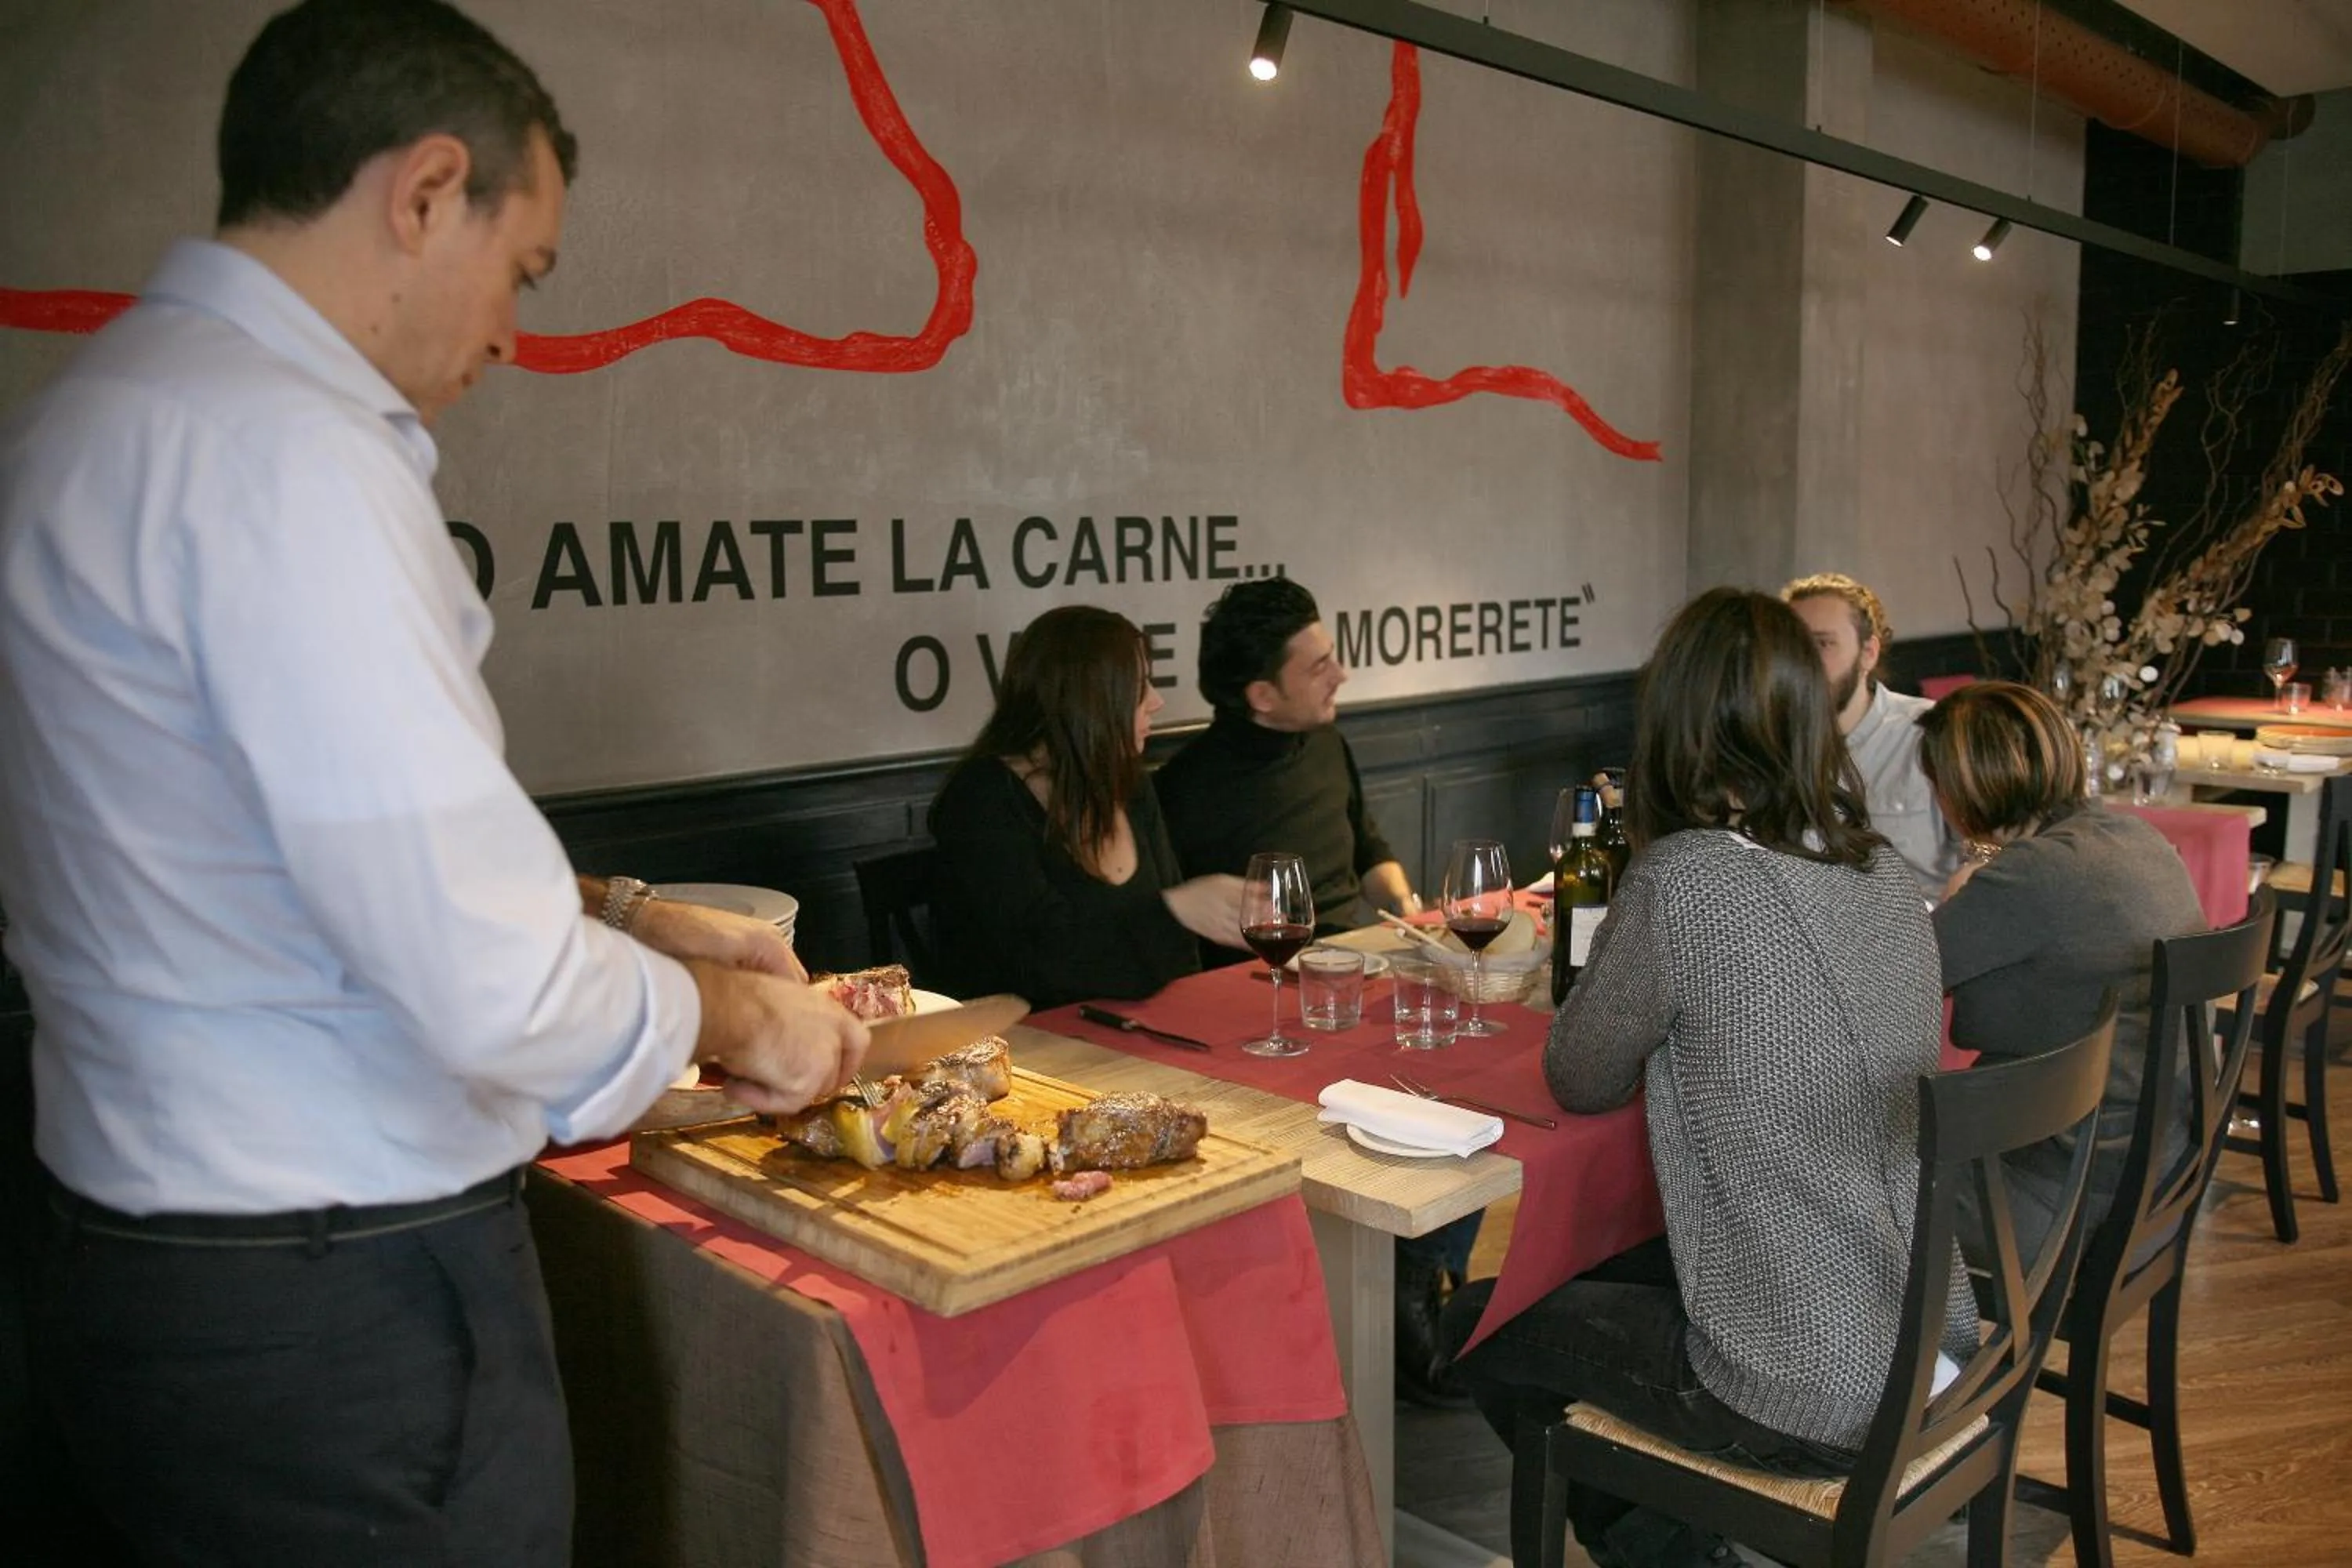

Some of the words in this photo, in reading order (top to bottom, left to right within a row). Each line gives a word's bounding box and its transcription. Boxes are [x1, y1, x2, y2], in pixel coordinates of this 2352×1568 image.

[530, 519, 861, 610] AMATE
[891, 517, 990, 593] LA
[1011, 515, 1286, 589] CARNE...
[895, 635, 950, 713] O
[1336, 583, 1595, 669] MORERETE"
